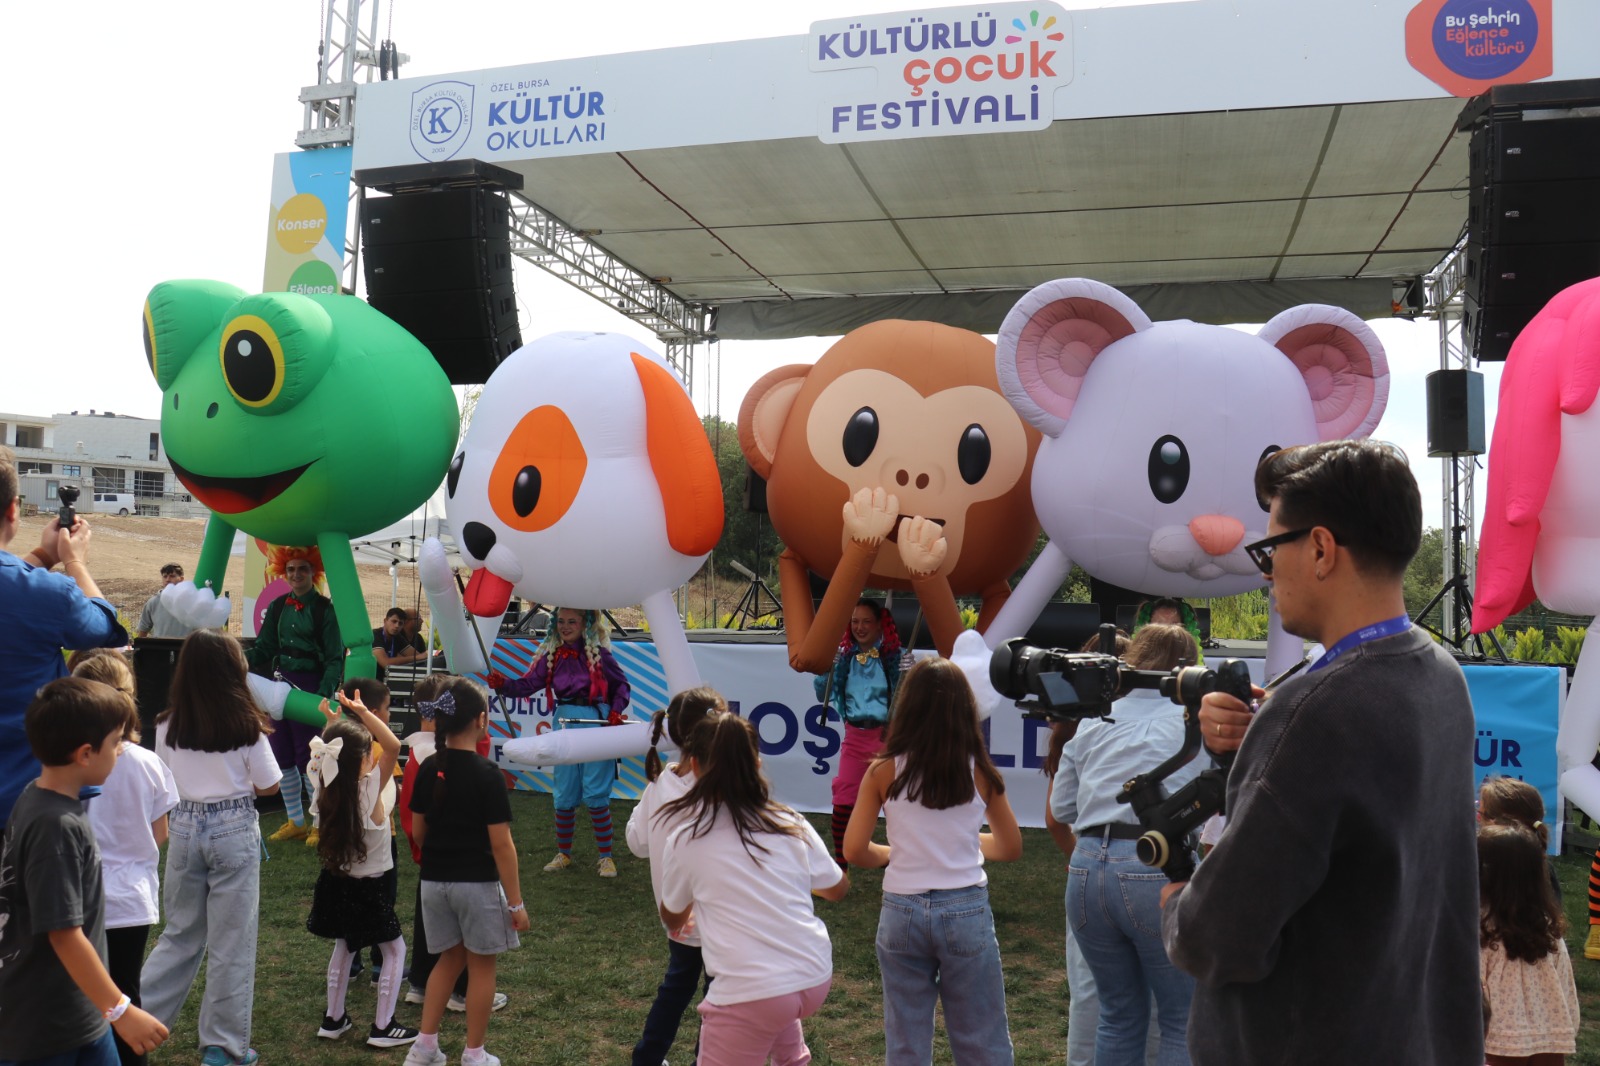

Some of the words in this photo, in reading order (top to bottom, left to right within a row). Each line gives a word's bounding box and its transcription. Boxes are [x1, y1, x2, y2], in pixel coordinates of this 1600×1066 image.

[1445, 15, 1465, 27] Bu
[1469, 7, 1520, 28] Şehrin
[818, 11, 997, 61] KÜLTÜRLÜ
[1446, 25, 1509, 44] Eğlence
[1465, 38, 1525, 57] kültürü
[490, 82, 514, 93] ÖZEL
[517, 79, 550, 90] BURSA
[428, 106, 453, 135] K
[488, 86, 605, 127] KÜLTÜR
[832, 84, 1039, 134] FESTİVALİ
[486, 122, 606, 151] OKULLARI
[277, 218, 325, 232] Konser
[728, 701, 841, 775] OŞ
